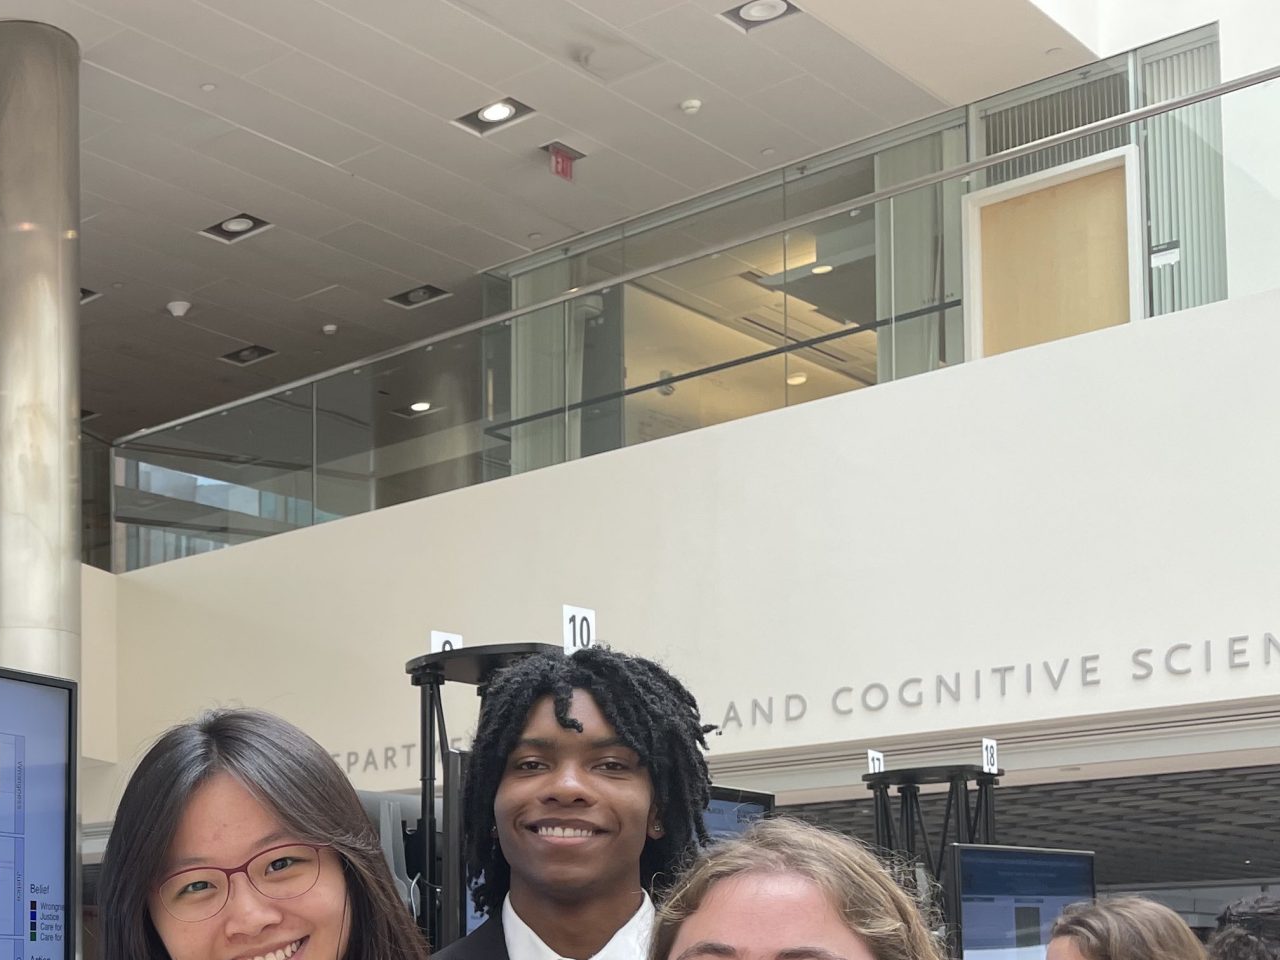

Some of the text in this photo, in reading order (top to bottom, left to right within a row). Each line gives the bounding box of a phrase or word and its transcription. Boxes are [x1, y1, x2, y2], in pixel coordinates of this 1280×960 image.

[569, 614, 591, 649] 10
[722, 693, 807, 730] AND
[831, 653, 1102, 716] COGNITIVE
[985, 744, 995, 767] 18
[871, 756, 881, 773] 17
[30, 883, 50, 895] Belief
[40, 912, 60, 921] Justice
[40, 922, 54, 931] Care
[40, 932, 54, 942] Care
